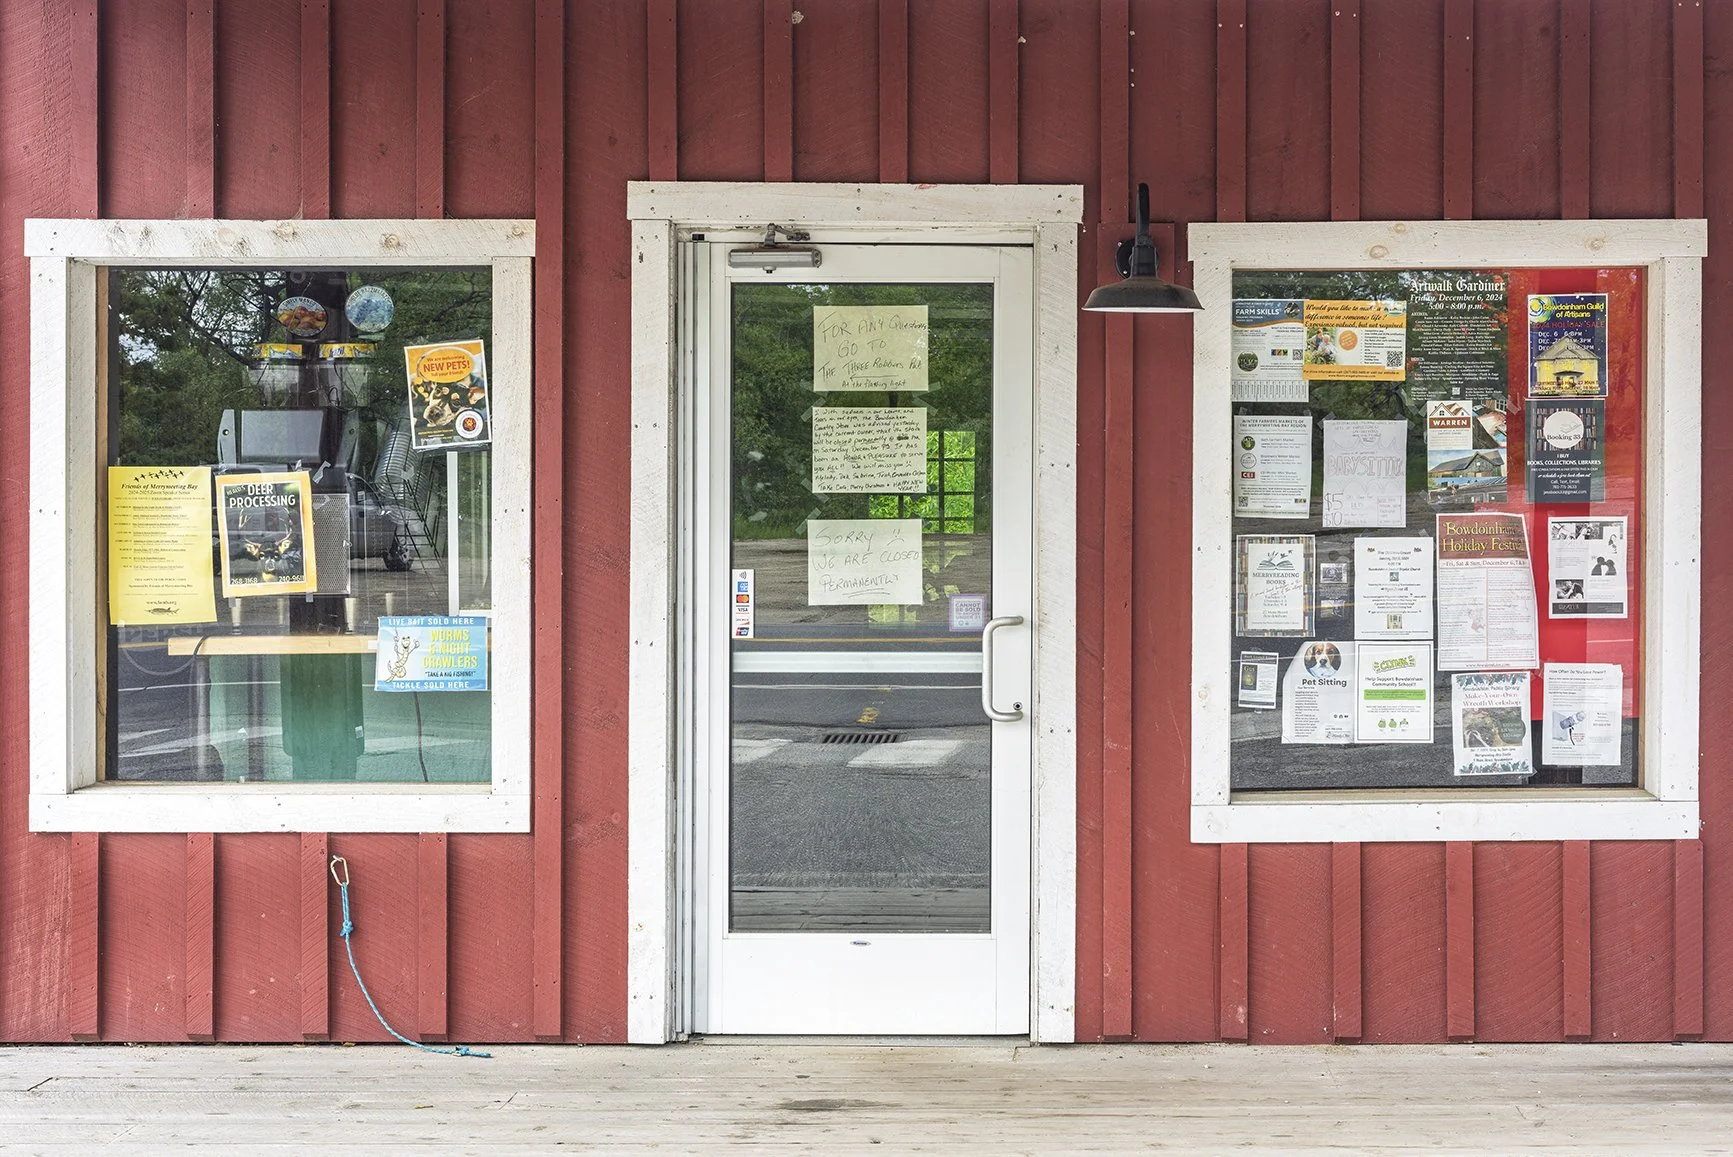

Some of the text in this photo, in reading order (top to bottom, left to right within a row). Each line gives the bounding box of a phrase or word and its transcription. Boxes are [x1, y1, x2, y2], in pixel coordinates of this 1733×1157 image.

[1410, 278, 1506, 293] Artwalk Gardiner
[1410, 294, 1437, 302] Friday,
[1328, 305, 1339, 314] you
[1543, 302, 1604, 311] Bowdoinham Guild
[858, 318, 884, 334] ANY
[837, 338, 887, 358] GO TO
[423, 360, 470, 372] NEW PETS!
[818, 360, 836, 382] THE
[842, 358, 870, 376] THREE
[247, 483, 274, 496] DEER
[229, 494, 296, 508] PROCESSING
[1324, 492, 1344, 512] $5
[1324, 511, 1342, 526] $10
[1443, 522, 1515, 535] Bowdoinham
[812, 526, 874, 552] SORRY
[1442, 538, 1488, 556] Holiday
[812, 550, 920, 571] WE ARE CLOSED
[819, 573, 899, 592] PERMANENTLY
[430, 629, 470, 642] WORMS
[429, 642, 470, 654] & NIGHT
[422, 656, 478, 668] CRAWLERS
[448, 681, 470, 689] HERE
[1318, 678, 1347, 687] Sitting
